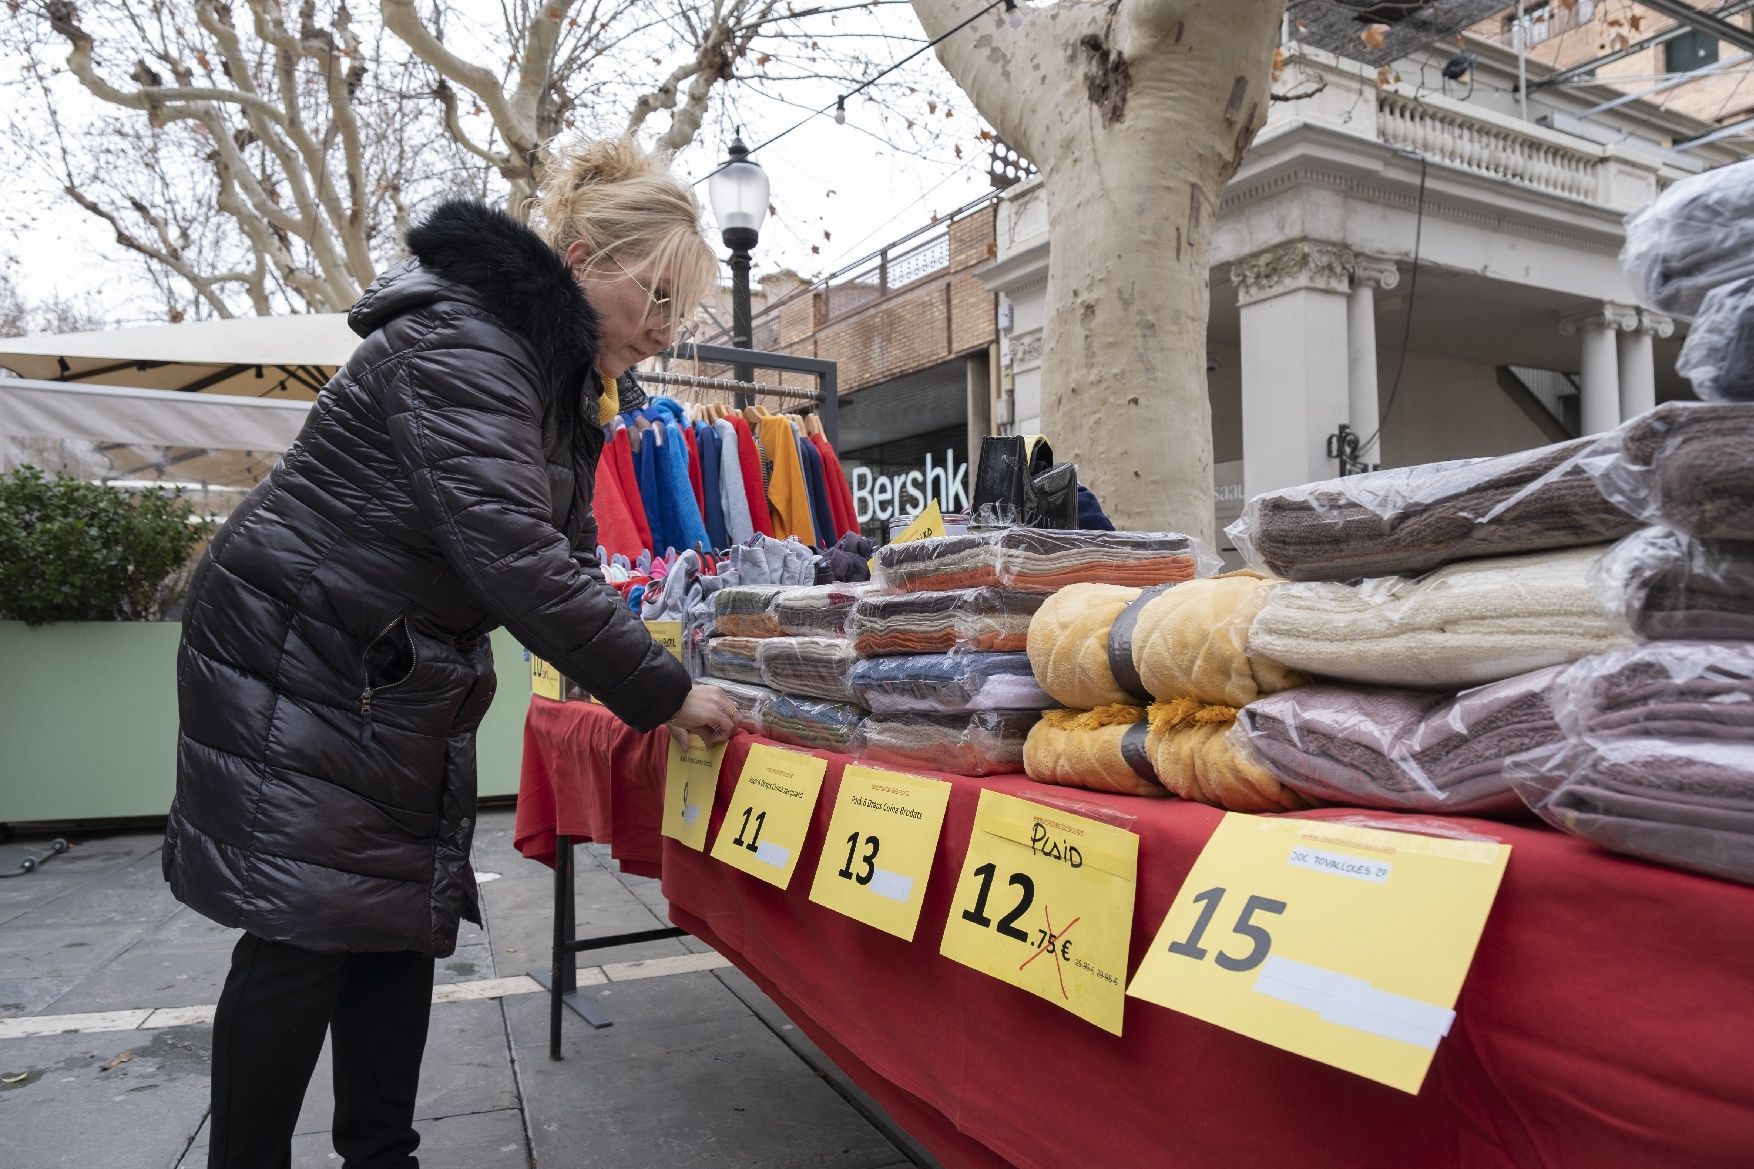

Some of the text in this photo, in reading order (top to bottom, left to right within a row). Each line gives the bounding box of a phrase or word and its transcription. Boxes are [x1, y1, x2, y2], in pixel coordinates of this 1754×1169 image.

[733, 806, 767, 853] 11
[838, 831, 880, 886] 13
[1167, 885, 1288, 973] 15
